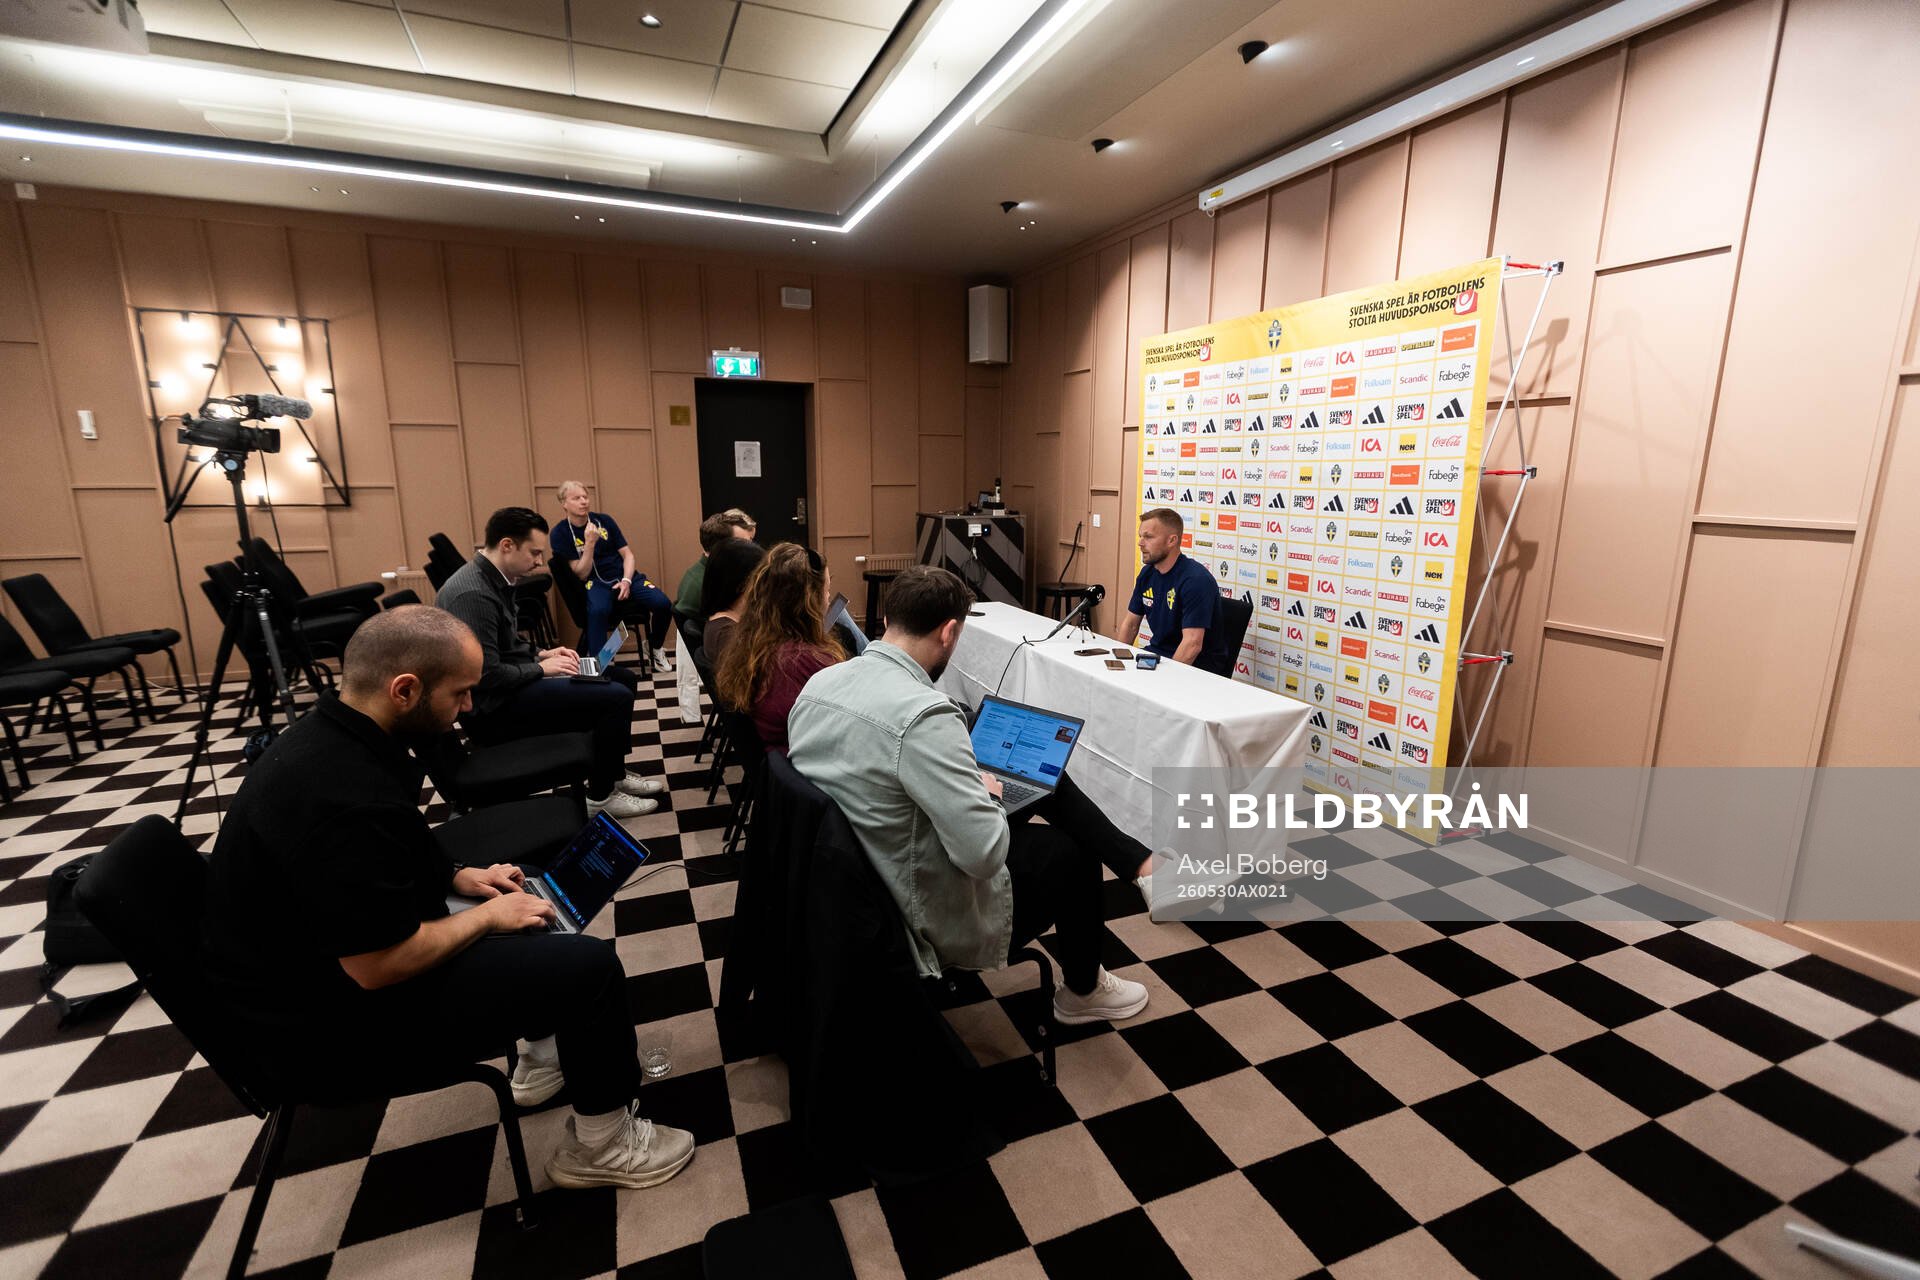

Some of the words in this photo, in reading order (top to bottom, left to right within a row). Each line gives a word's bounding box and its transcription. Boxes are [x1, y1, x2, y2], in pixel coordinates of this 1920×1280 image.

[1350, 301, 1384, 316] SVENSKA
[1386, 297, 1405, 309] SPEL
[1407, 289, 1420, 303] ÄR
[1422, 277, 1485, 301] FOTBOLLENS
[1349, 316, 1377, 328] STOLTA
[1379, 298, 1456, 322] HUVUDSPONSOR
[1145, 345, 1164, 356] SVENSKA
[1165, 344, 1175, 353] SPEL
[1183, 337, 1215, 350] FOTBOLLENS
[1145, 354, 1160, 365] STOLTA
[1161, 348, 1201, 363] HUVUDSPONSOR
[1336, 351, 1355, 365] ICA
[1400, 374, 1428, 384] Scandic
[1439, 370, 1470, 382] Fabege
[1227, 393, 1240, 405] ICA
[1397, 403, 1425, 412] SVENSKA
[1330, 410, 1352, 418] SVENSKA
[1397, 412, 1410, 420] SPEL
[1270, 444, 1290, 452] Scandic
[1297, 443, 1318, 454] Fabege
[1361, 438, 1382, 452] ICA
[1222, 468, 1237, 480] ICA
[1244, 471, 1262, 481] Fabege
[1429, 470, 1459, 482] Fabege
[1355, 497, 1379, 505] SVENSKA
[1426, 499, 1456, 507] SVENSKA
[1425, 506, 1440, 514] SPEL
[1267, 521, 1282, 534] ICA
[1290, 525, 1313, 534] Scandic
[1385, 532, 1412, 545] Fabege
[1424, 532, 1449, 547] ICA
[1240, 544, 1258, 556] Fabege
[1347, 558, 1374, 568] Folksam
[1318, 580, 1336, 594] ICA
[1344, 586, 1372, 597] Scandic
[1378, 592, 1409, 603] BAUHAUS
[1314, 606, 1336, 614] SVENSKA
[1416, 598, 1445, 612] Fabege
[1378, 617, 1403, 625] SVENSKA
[1287, 627, 1303, 641] ICA
[1378, 624, 1390, 632] SPEL
[1283, 654, 1303, 667] Fabege
[1374, 650, 1400, 662] Scandic
[1234, 662, 1250, 676] ICA
[1337, 719, 1359, 730] SVENSKA
[1406, 713, 1429, 733] ICA
[1336, 725, 1348, 735] SPEL
[1401, 747, 1415, 758] SPEL
[1402, 741, 1429, 752] SVENSKA
[1332, 747, 1359, 764] BAUHAUS
[1334, 773, 1352, 791] ICA
[1398, 773, 1426, 790] Folksam
